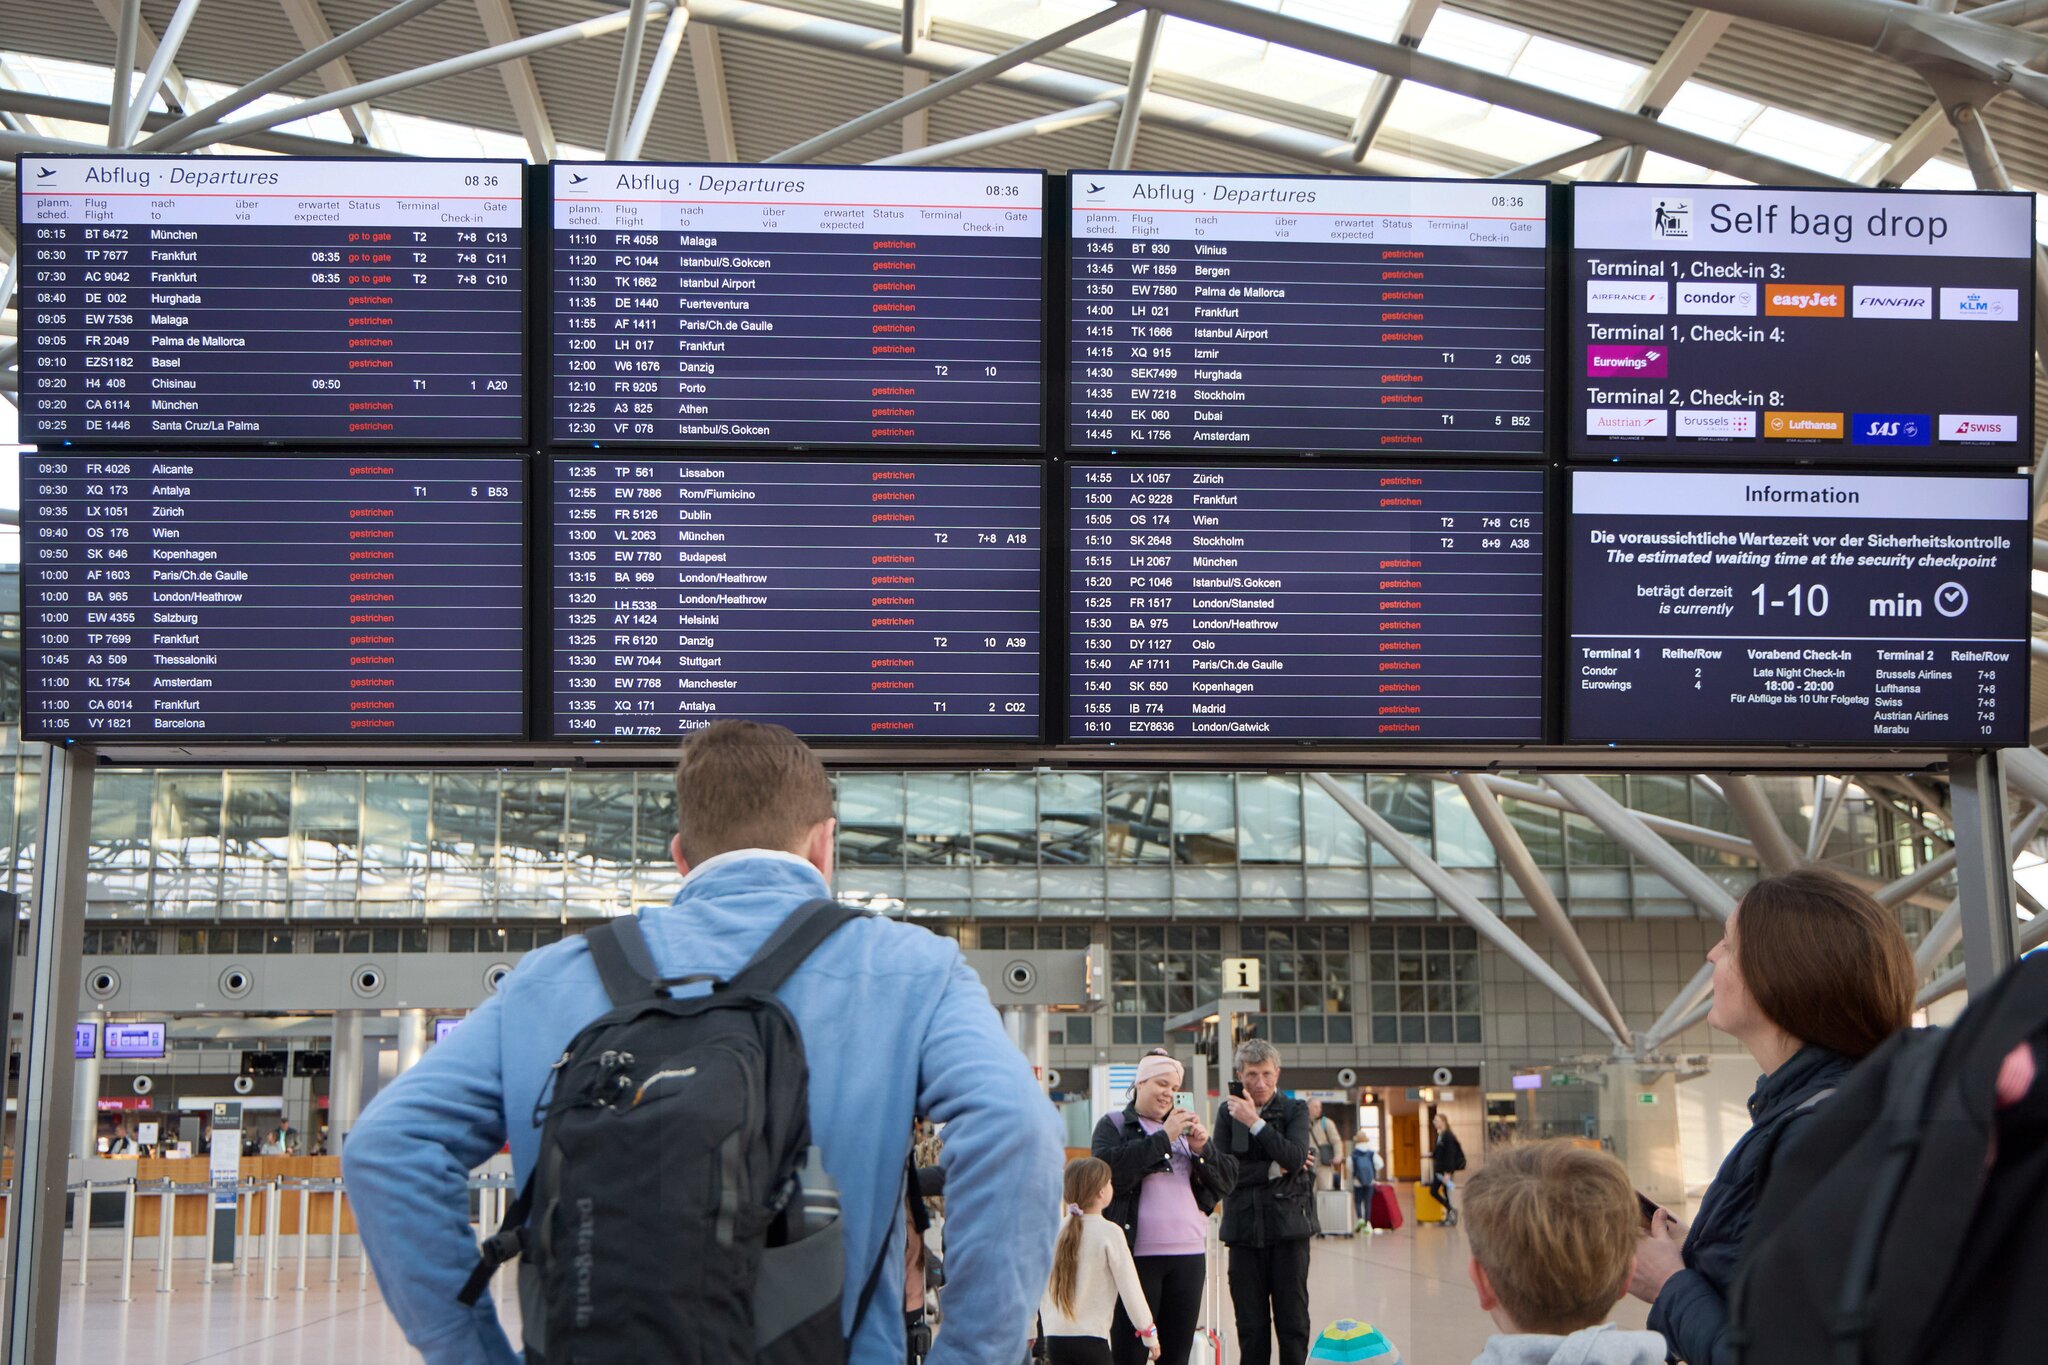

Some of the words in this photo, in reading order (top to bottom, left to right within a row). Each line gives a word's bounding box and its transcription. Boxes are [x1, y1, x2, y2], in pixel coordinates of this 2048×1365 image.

[85, 167, 149, 187] Abflug
[170, 168, 278, 187] Departures
[616, 174, 679, 194] Abflug
[699, 176, 804, 195] Departures
[986, 186, 1018, 196] 08:36
[1132, 184, 1194, 204] Abflug
[1214, 185, 1316, 204] Departures
[37, 198, 72, 208] planm.
[85, 198, 107, 210] Flug
[152, 200, 175, 208] nach
[236, 200, 258, 208] über
[348, 200, 380, 209] Status
[397, 201, 440, 210] Terminal
[484, 202, 507, 211] Gate
[1492, 196, 1523, 207] 08:36
[37, 210, 69, 219] sched.
[85, 210, 113, 222] Flight
[151, 212, 162, 220] to
[236, 212, 250, 220] via
[294, 213, 340, 222] expected
[441, 213, 483, 222] Check-in
[1711, 204, 1778, 233] Self
[1791, 206, 1852, 243] bag
[1868, 208, 1947, 245] drop
[37, 229, 66, 238] 06:15
[86, 229, 100, 238] BT
[103, 230, 128, 239] 6472
[151, 230, 198, 240] München
[349, 234, 360, 242] go
[372, 233, 391, 242] gate
[413, 232, 426, 242] T2
[457, 232, 476, 242] 7+8
[486, 232, 508, 242] C13
[570, 234, 596, 244] 11:10
[616, 235, 630, 244] FR
[634, 235, 658, 245] 4058
[680, 236, 717, 248] Malaga
[873, 241, 916, 250] gestrichen
[1587, 260, 1664, 276] Terminal
[1671, 262, 1685, 279] 1,
[1691, 261, 1764, 278] Check-in
[1770, 264, 1784, 278] 3:
[1087, 284, 1113, 294] 13:50
[1132, 285, 1150, 295] EW
[1153, 286, 1177, 295] 7580
[1195, 286, 1226, 296] Palma
[1228, 287, 1241, 296] de
[1244, 287, 1285, 297] Mallorca
[1380, 292, 1423, 300] gestrichen
[1684, 292, 1735, 304] condor
[1773, 293, 1837, 308] easyJet
[1860, 298, 1925, 306] FINNAIR
[1960, 302, 1987, 310] KLM
[1587, 324, 1664, 340] Terminal
[1671, 326, 1684, 343] 1,
[1690, 325, 1764, 342] Check-in
[1770, 327, 1784, 342] 4:
[1594, 357, 1647, 370] Eurowings
[1587, 388, 1663, 404] Terminal
[1670, 389, 1684, 406] 2,
[1690, 389, 1763, 406] Check-in
[1769, 391, 1784, 406] 8:
[1598, 417, 1641, 426] Austrian
[1684, 416, 1728, 426] brussels
[1787, 418, 1837, 430] Lufthansa
[1867, 422, 1900, 436] SAS
[1970, 424, 2001, 432] SWISS
[39, 464, 68, 474] 09:30
[87, 464, 102, 473] FR
[105, 464, 130, 474] 4026
[152, 464, 194, 474] Alicante
[350, 466, 394, 476] gestrichen
[1746, 486, 1859, 503] Information
[1086, 514, 1112, 524] 15:05
[1130, 515, 1146, 524] OS
[1153, 515, 1170, 524] 174
[1193, 515, 1218, 525] Wien
[1441, 518, 1454, 527] T2
[1482, 518, 1500, 528] 7+8
[1510, 518, 1530, 528] C15
[569, 530, 596, 540] 13:00
[614, 530, 628, 540] VL
[631, 530, 656, 540] 2063
[679, 531, 724, 540] München
[934, 533, 948, 543] T2
[978, 534, 996, 543] 7+8
[1007, 534, 1026, 544] A18
[1591, 530, 1615, 543] Die
[1619, 531, 1737, 545] voraussichtliche
[1739, 532, 1808, 546] Wartezeit
[1812, 537, 1836, 546] vor
[1840, 534, 1864, 546] der
[1868, 534, 2010, 548] Sicherheitskontrolle
[1607, 550, 1634, 562] The
[1638, 550, 1712, 564] estimated
[1716, 551, 1770, 567] waiting
[1774, 552, 1808, 565] time
[1811, 554, 1827, 565] at
[1830, 552, 1854, 565] the
[1857, 554, 1915, 569] security
[1918, 554, 1997, 570] checkpoint
[1637, 584, 1685, 600] beträgt
[1688, 585, 1732, 597] derzeit
[1752, 584, 1828, 616] 1-10
[1870, 593, 1922, 616] min
[1659, 602, 1670, 614] is
[1674, 603, 1734, 617] currently
[1582, 648, 1631, 658] Terminal
[1634, 649, 1640, 658] 1
[1662, 648, 1722, 659] Reihe/Row
[1747, 649, 1800, 660] Vorabend
[1803, 650, 1851, 660] Check-In
[1877, 650, 1924, 660] Terminal
[1927, 650, 1934, 660] 2
[1952, 651, 2009, 661] Reihe/Row
[1582, 666, 1618, 675] Condor
[1695, 668, 1701, 677] 2
[1754, 668, 1774, 677] Late
[1776, 668, 1801, 679] Night
[1803, 668, 1845, 677] Check-In
[1876, 670, 1916, 679] Brussels
[1918, 670, 1952, 679] Airlines
[1978, 670, 1996, 680] 7+8
[1582, 680, 1632, 692] Eurowings
[1694, 681, 1701, 690] 4
[1765, 681, 1794, 691] 18:00
[1804, 681, 1834, 691] 20:00
[1876, 684, 1920, 693] Lufthansa
[1978, 684, 1996, 694] 7+8
[1731, 694, 1746, 702] Für
[1748, 694, 1782, 705] Abflüge
[1784, 694, 1797, 703] bis
[1800, 694, 1810, 703] 10
[1812, 695, 1829, 703] Uhr
[1831, 694, 1869, 706] Folgetag
[1875, 697, 1902, 706] Swiss
[1978, 698, 1995, 707] 7+8
[1874, 711, 1912, 720] Austrian
[1914, 712, 1948, 720] Airlines
[1977, 712, 1995, 721] 7+8
[1874, 724, 1909, 734] Marabu
[1981, 725, 1992, 734] 10
